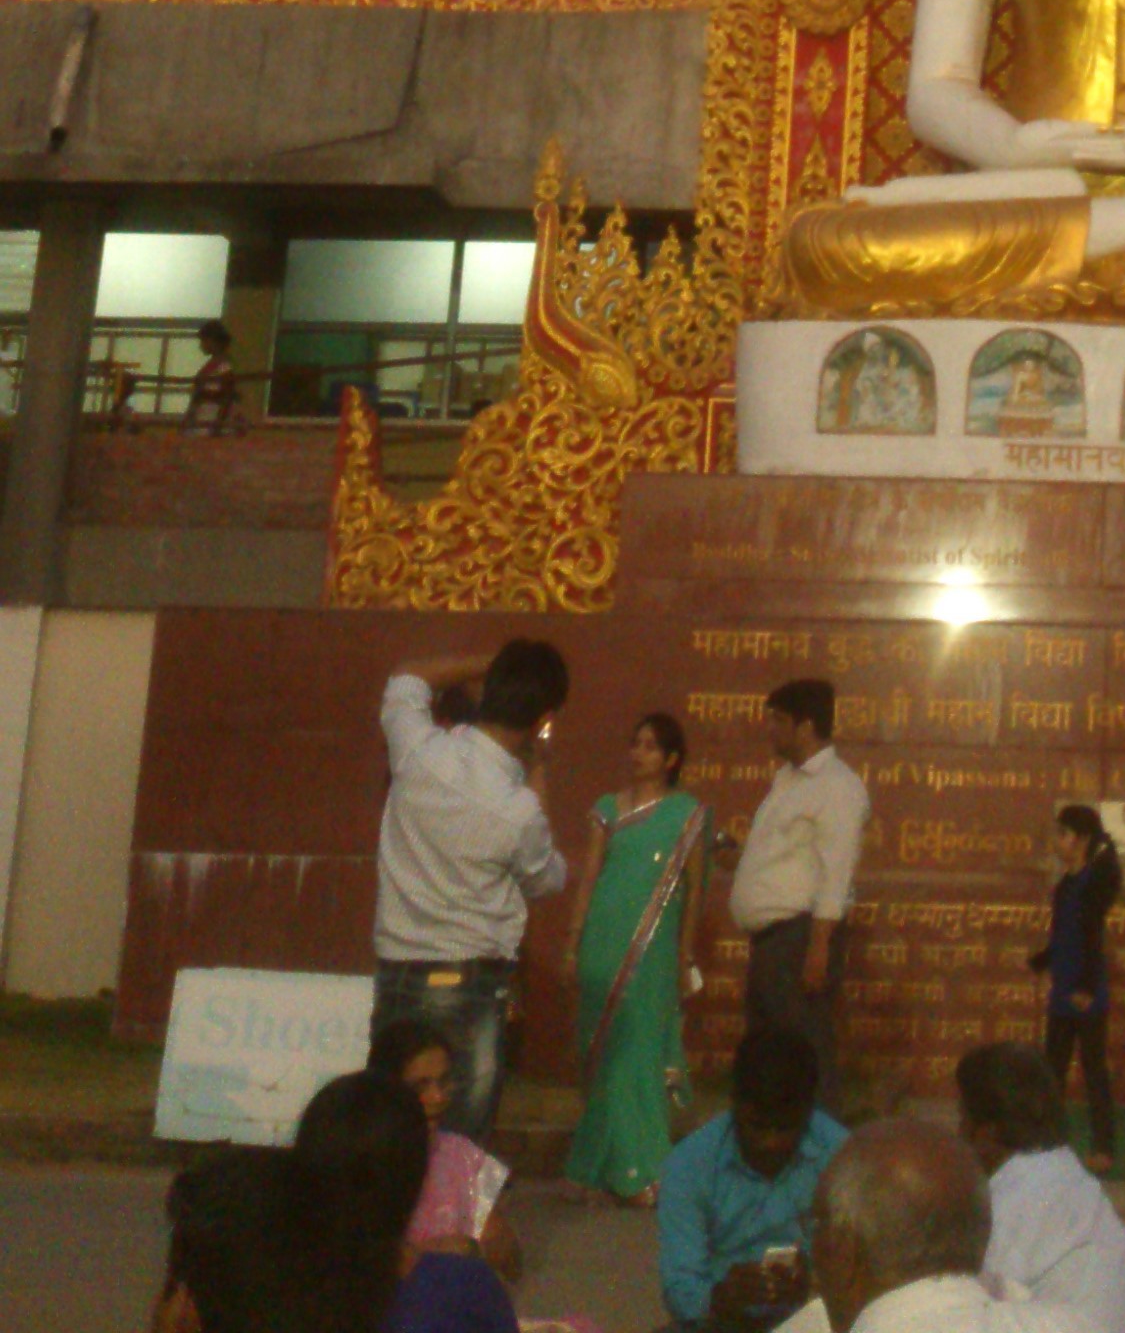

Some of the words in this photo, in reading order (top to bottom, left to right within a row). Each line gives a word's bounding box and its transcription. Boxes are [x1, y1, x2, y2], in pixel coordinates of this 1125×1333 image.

[692, 630, 812, 661] महामानव
[877, 762, 902, 783] of
[910, 762, 1032, 791] Vipassana
